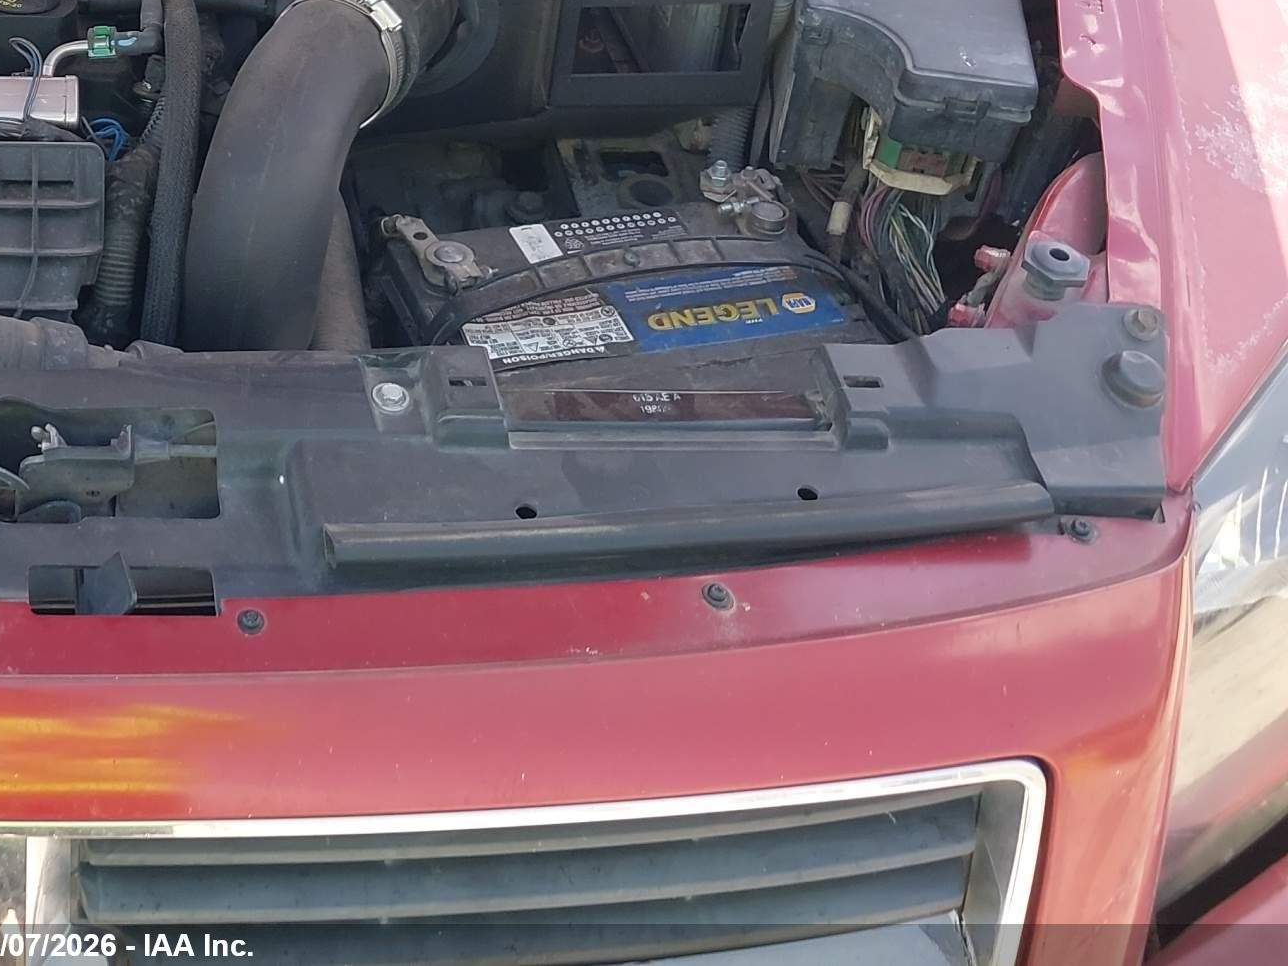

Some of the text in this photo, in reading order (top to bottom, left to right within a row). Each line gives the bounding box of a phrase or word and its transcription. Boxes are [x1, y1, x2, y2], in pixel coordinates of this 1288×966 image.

[648, 296, 812, 331] NAPA LEGEND
[502, 346, 595, 365] DANGER/POISON
